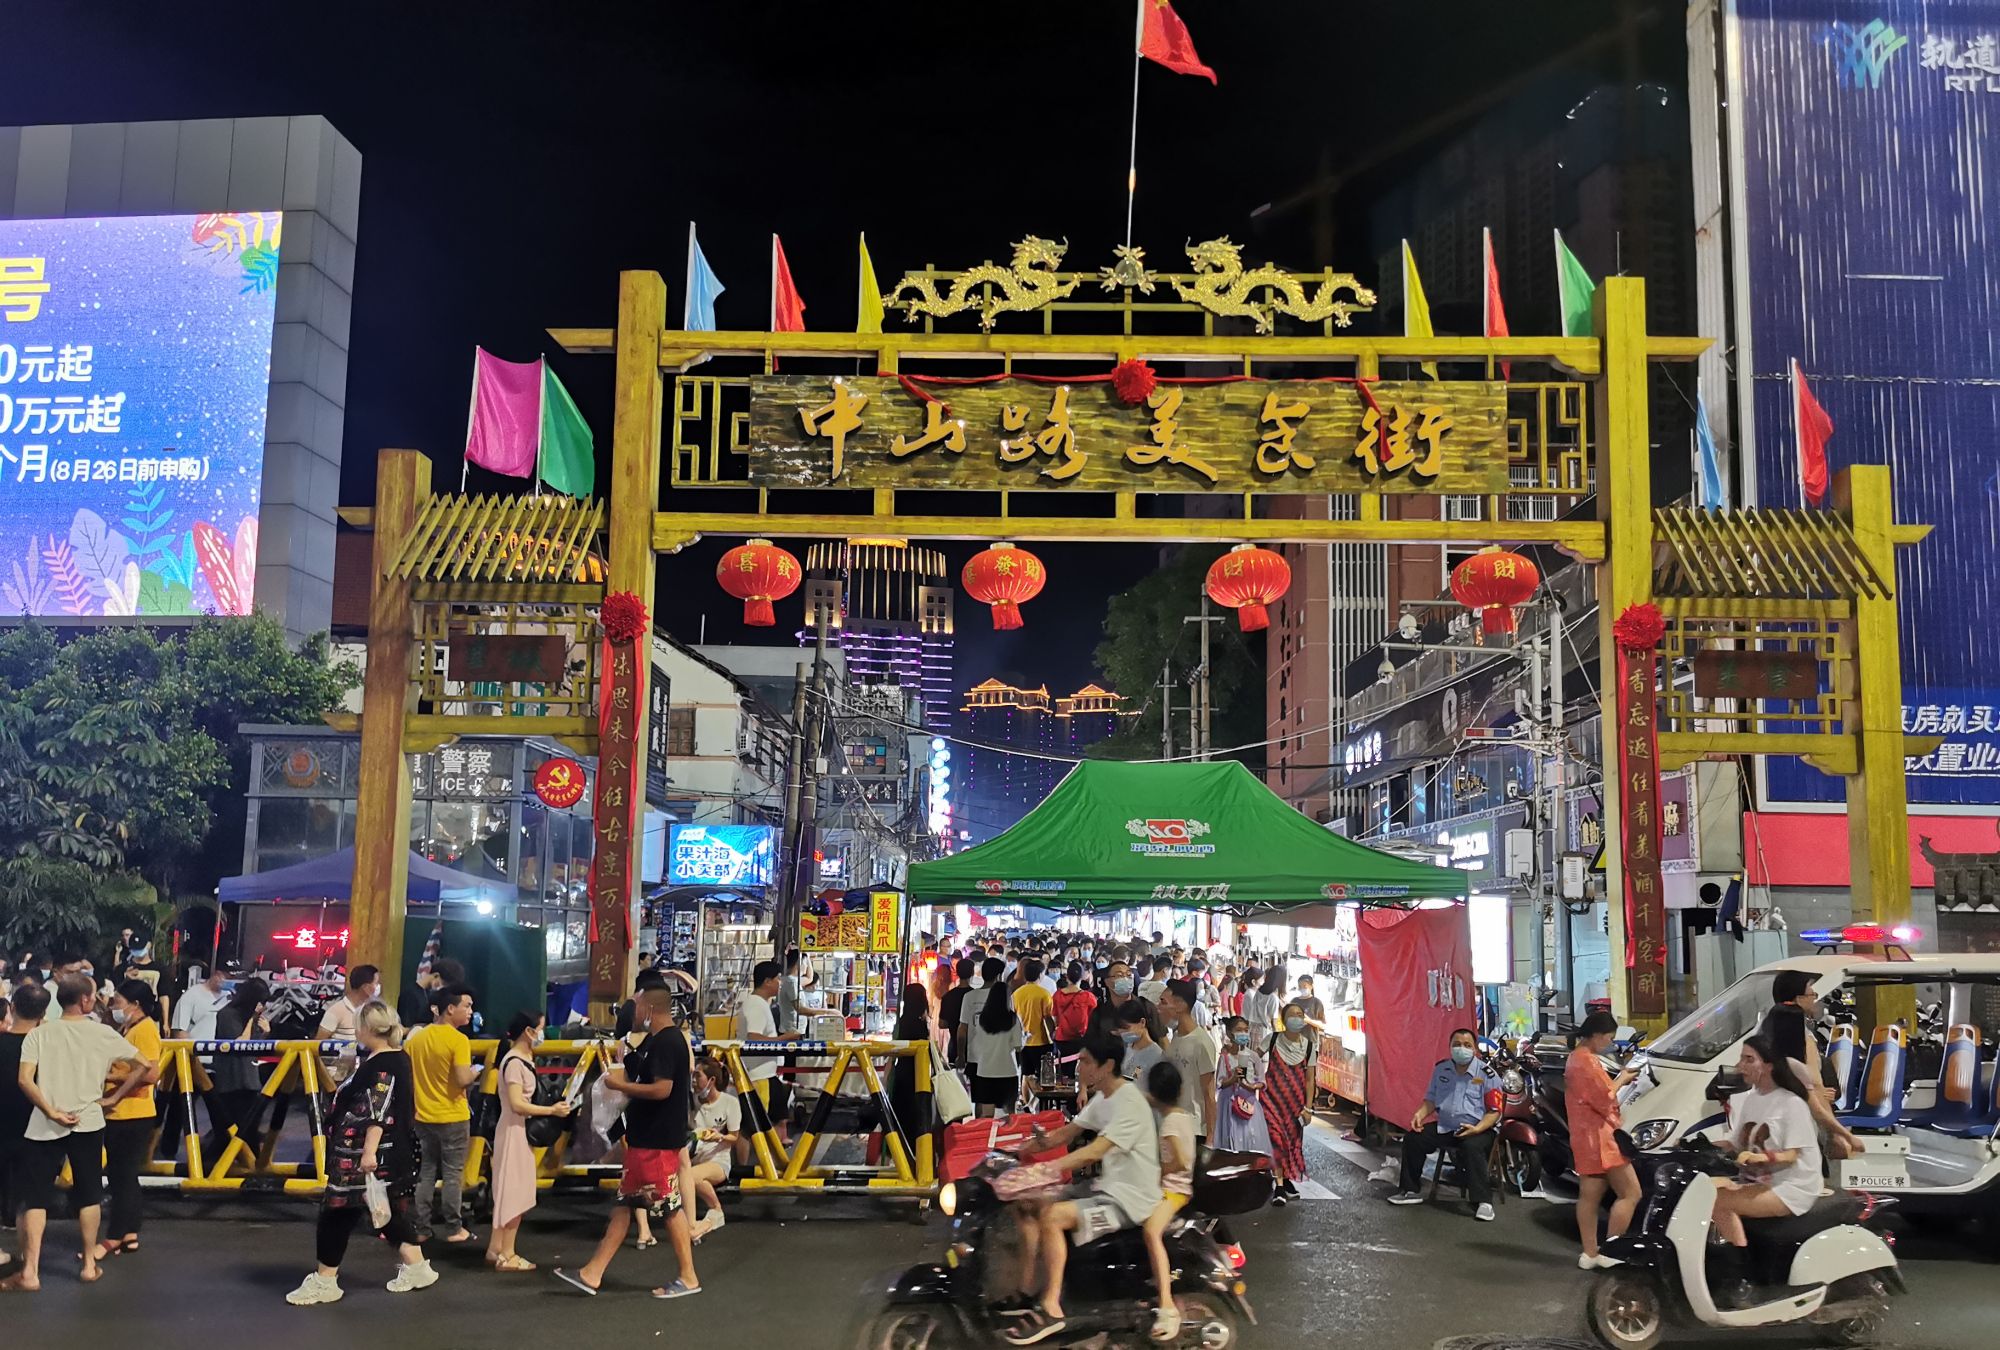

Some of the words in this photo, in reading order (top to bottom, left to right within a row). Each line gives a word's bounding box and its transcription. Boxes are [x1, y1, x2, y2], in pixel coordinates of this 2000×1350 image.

[801, 384, 1455, 482] 中山路美食街
[441, 749, 492, 775] 警察
[876, 897, 892, 948] 爱啃凤爪
[1861, 1177, 1893, 1186] POLICE
